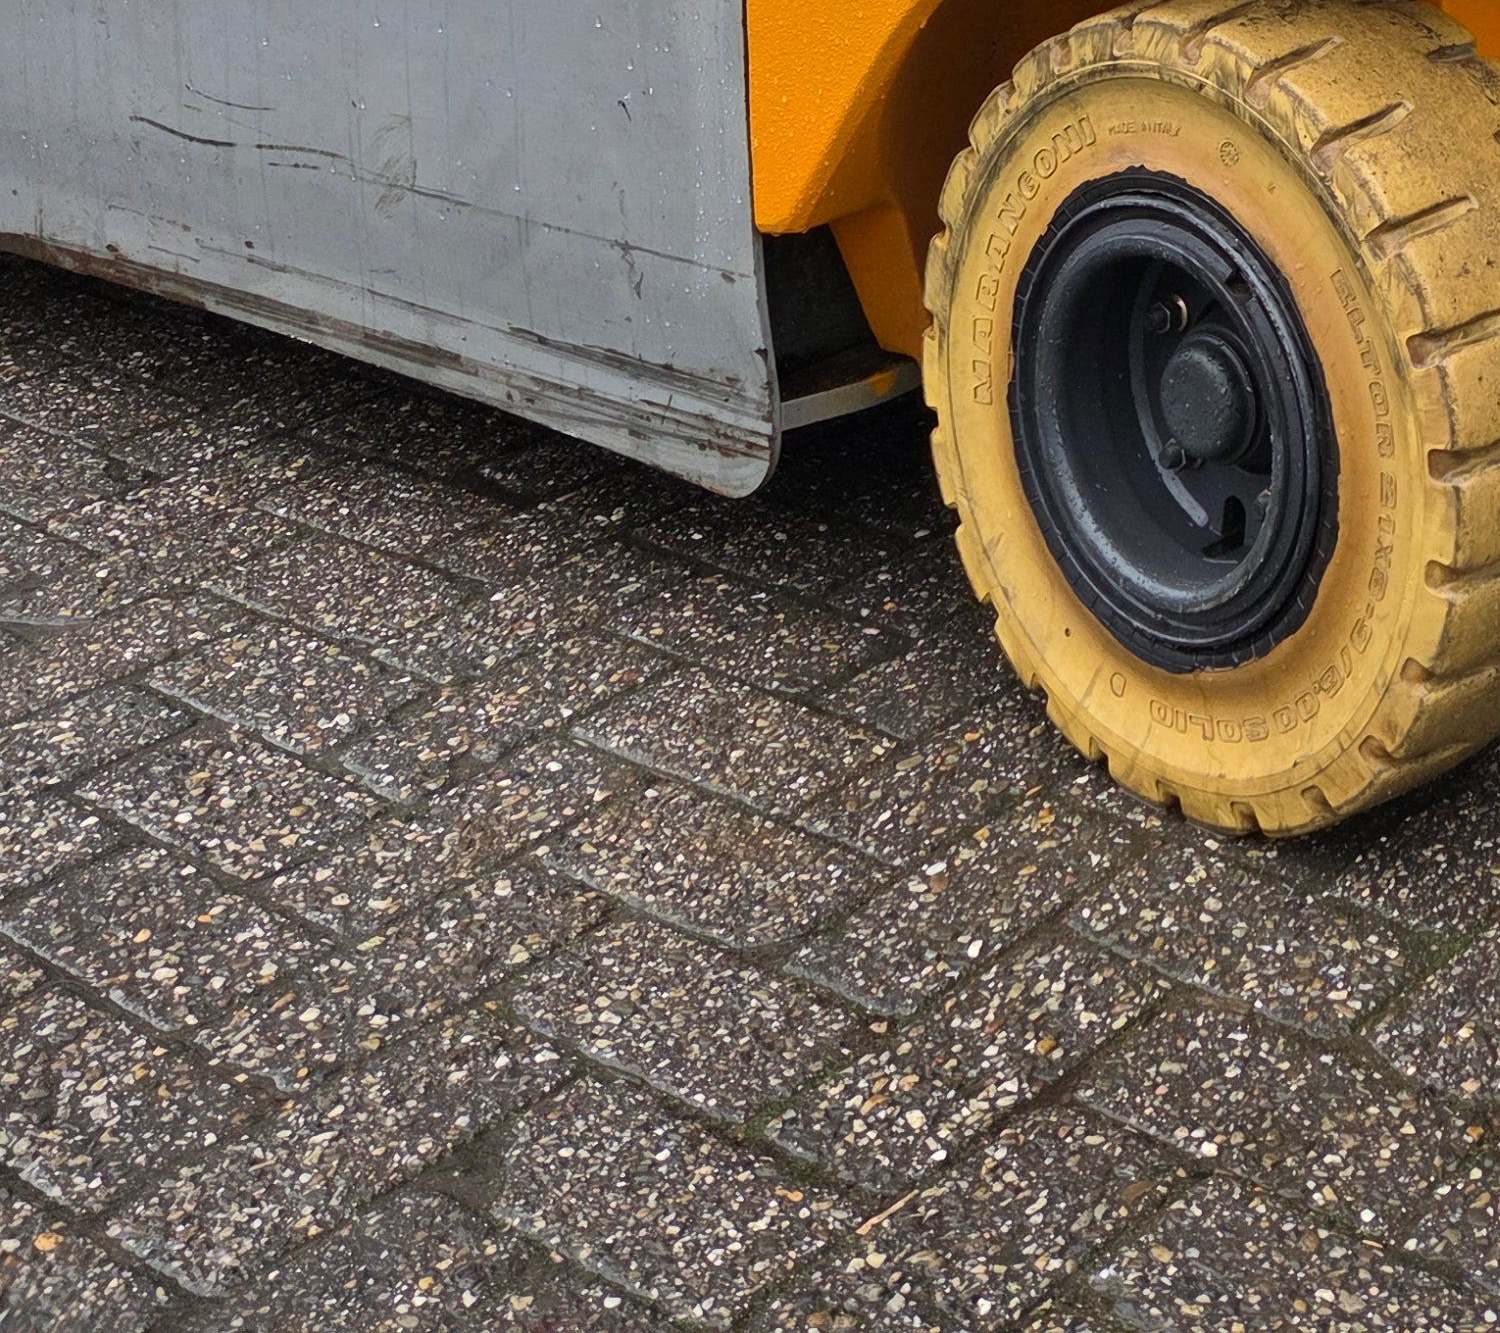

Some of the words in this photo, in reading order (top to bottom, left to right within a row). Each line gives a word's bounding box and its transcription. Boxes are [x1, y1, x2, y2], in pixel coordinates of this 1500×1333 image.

[972, 113, 1098, 406] MARANGONI
[1330, 268, 1396, 459] ELTOR
[1149, 698, 1269, 744] SOLID
